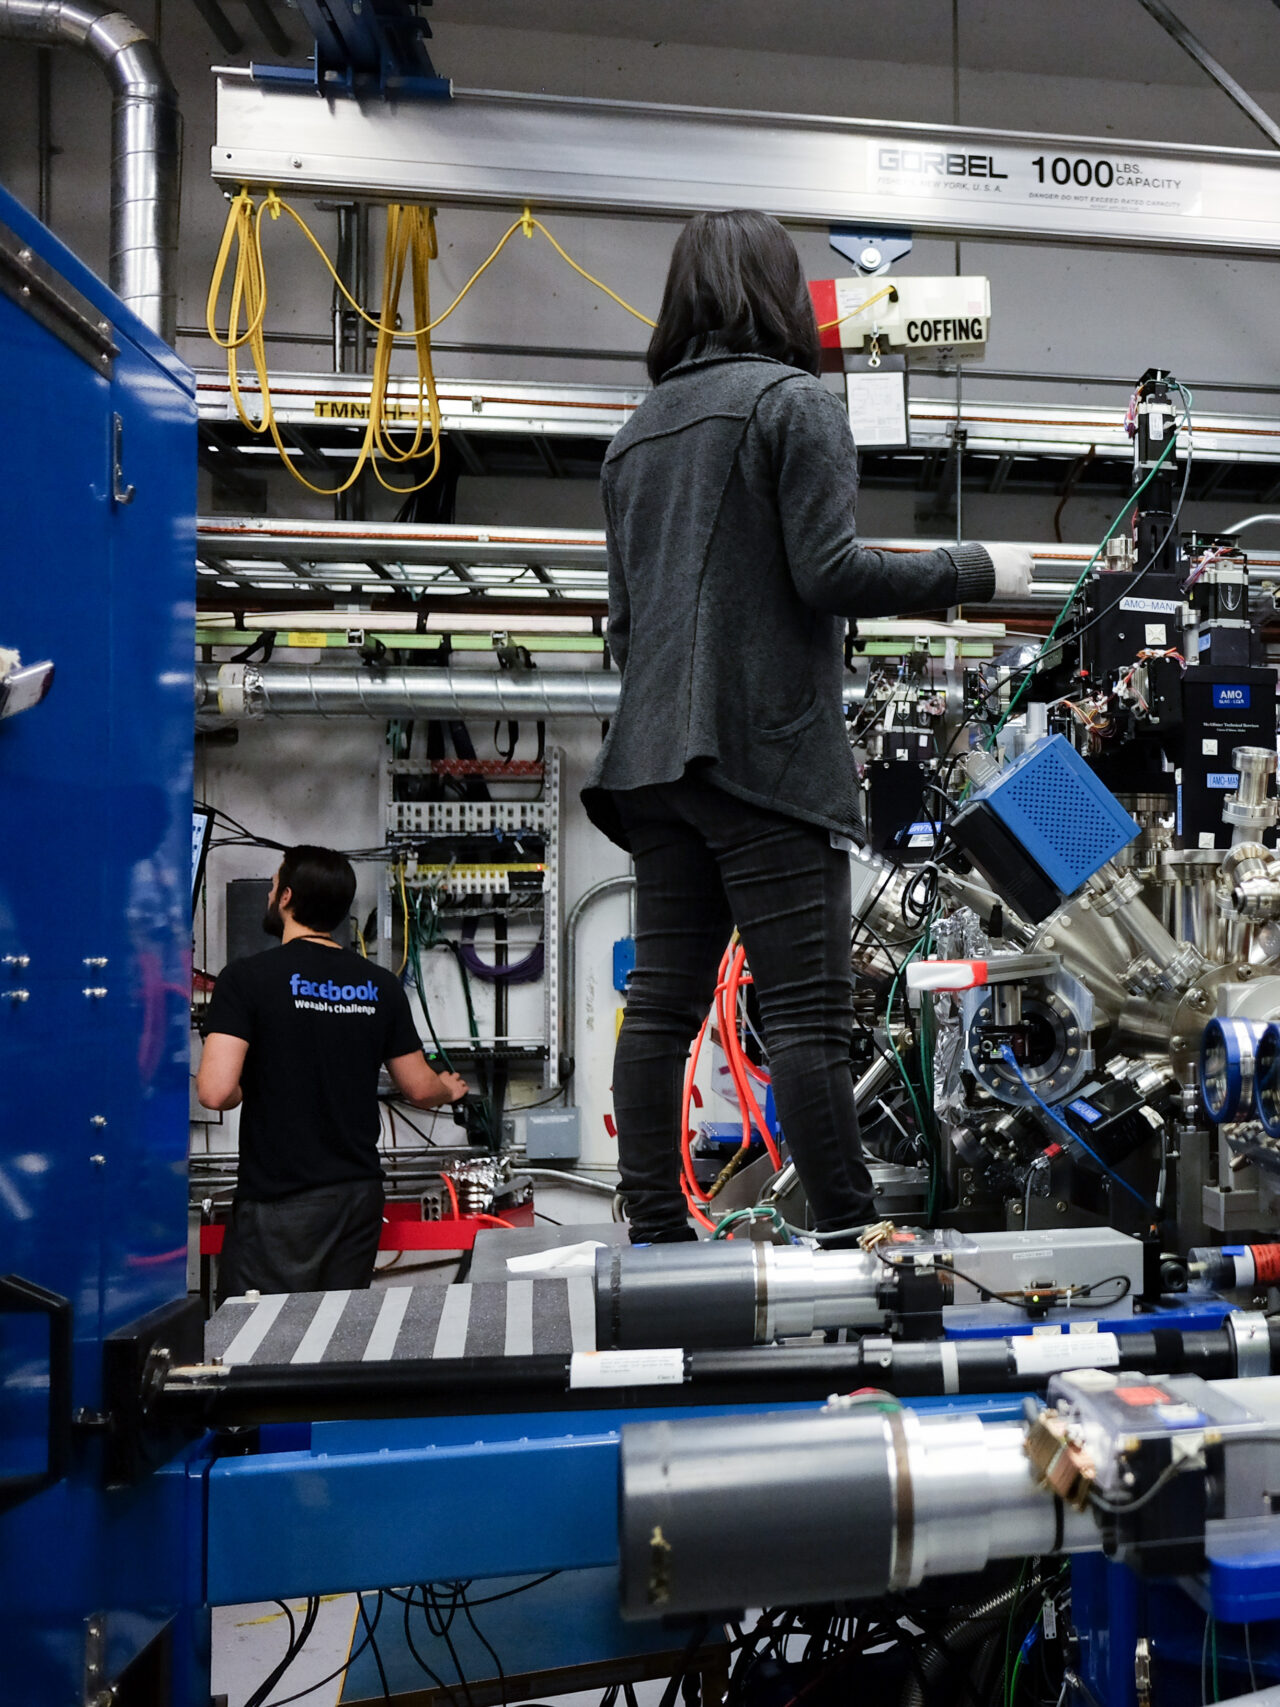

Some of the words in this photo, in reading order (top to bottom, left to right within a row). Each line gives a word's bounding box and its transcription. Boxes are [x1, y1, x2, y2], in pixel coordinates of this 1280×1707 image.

[878, 149, 1009, 179] GORBEL
[1032, 156, 1114, 188] 1000
[1116, 163, 1144, 175] LBS.
[1116, 175, 1182, 189] CAPACITY
[906, 317, 983, 343] COFFING
[1220, 689, 1243, 700] AMO
[289, 973, 379, 1001] facebook
[333, 1003, 376, 1015] Challenge
